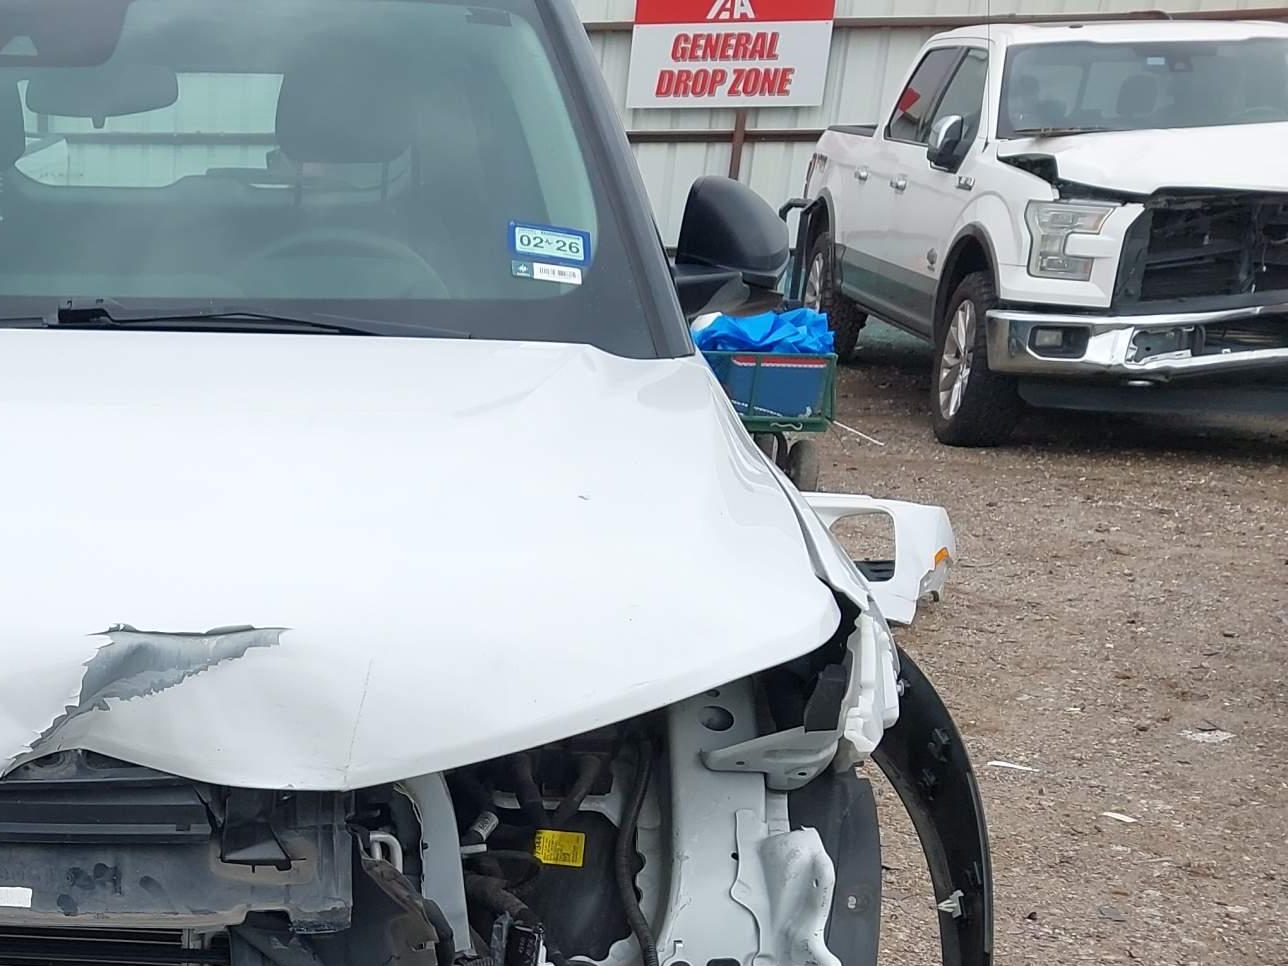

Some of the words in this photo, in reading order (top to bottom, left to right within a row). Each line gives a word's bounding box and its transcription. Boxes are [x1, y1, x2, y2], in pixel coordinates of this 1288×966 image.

[670, 32, 779, 62] GENERAL
[655, 69, 727, 97] DROP
[728, 68, 795, 97] ZONE
[519, 234, 544, 249] 02
[555, 239, 580, 254] 26
